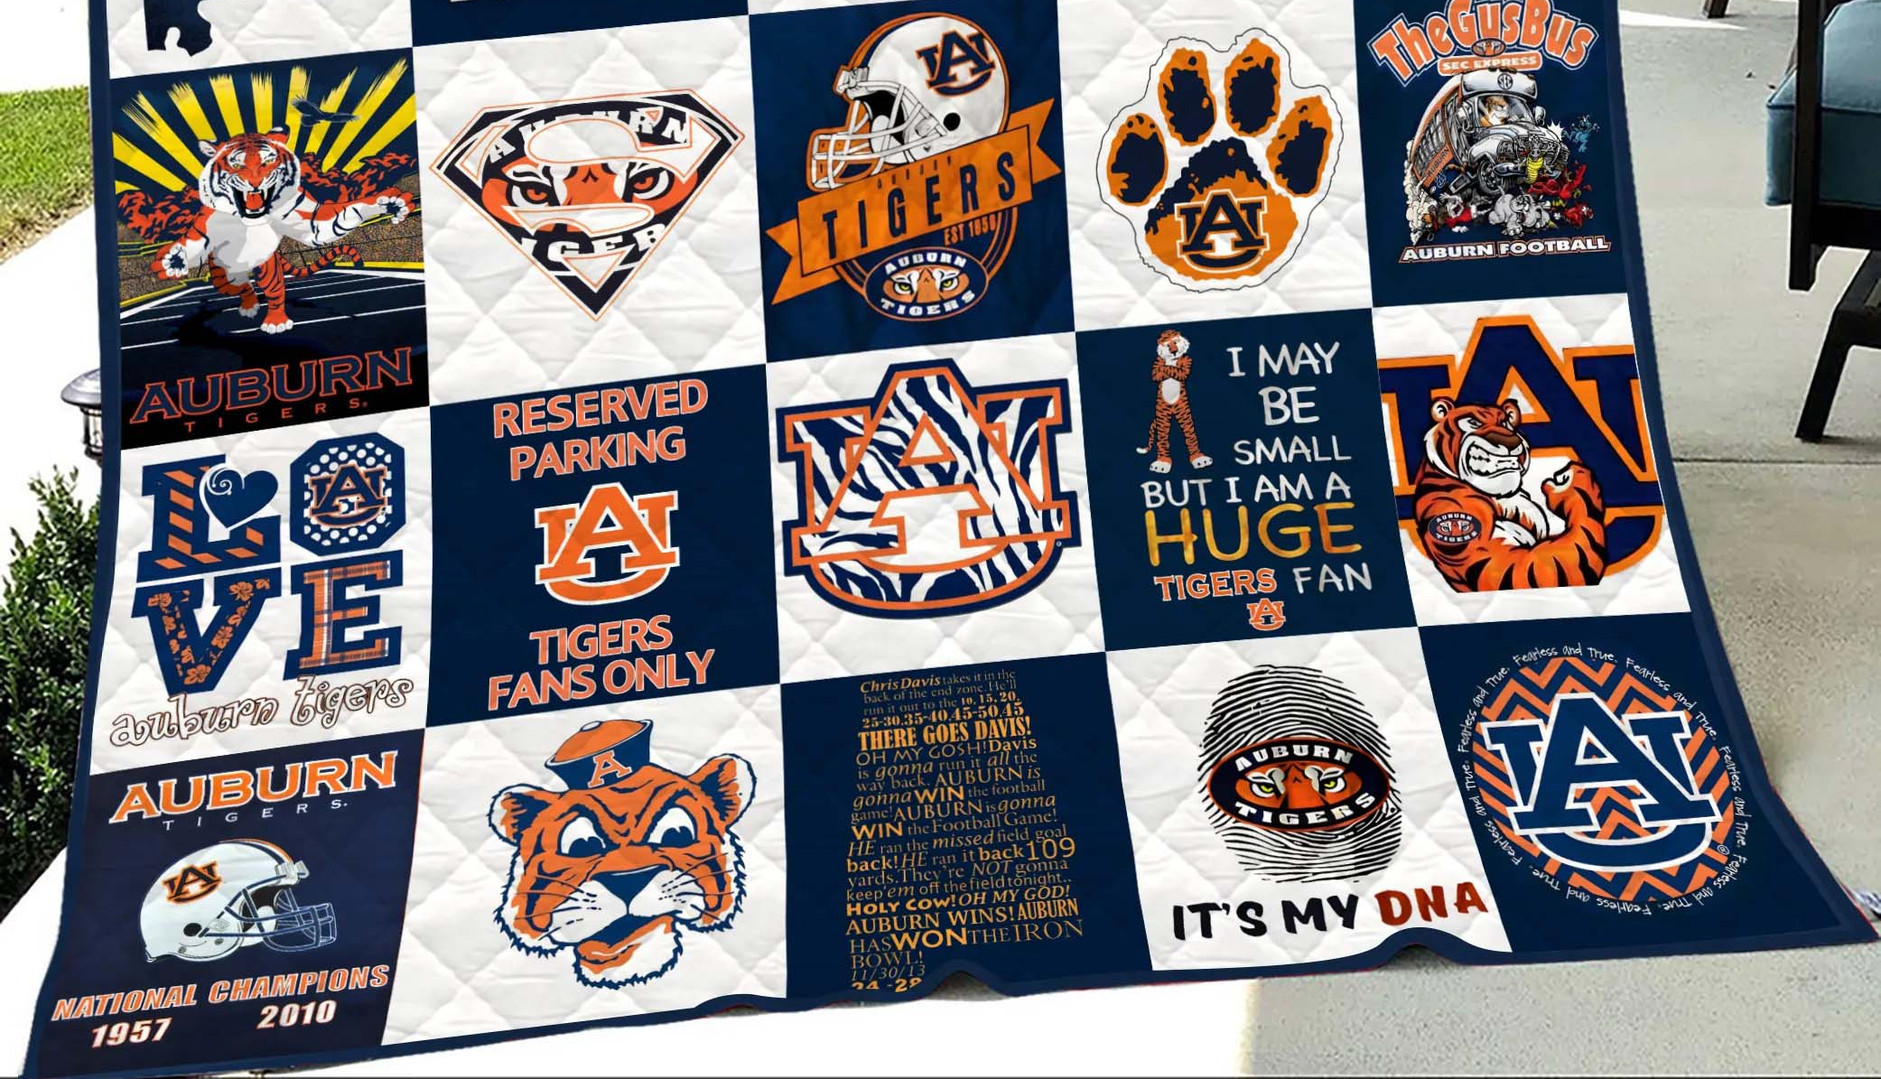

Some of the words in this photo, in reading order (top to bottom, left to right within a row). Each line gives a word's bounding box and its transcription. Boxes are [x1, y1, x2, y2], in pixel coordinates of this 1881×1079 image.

[1443, 60, 1469, 70] SEC
[1474, 56, 1537, 69] EXPRESS
[822, 151, 1015, 259] TIGERS
[944, 222, 964, 246] EST
[1403, 246, 1494, 262] AUBURN
[1500, 237, 1609, 256] FOOTBALL
[884, 252, 967, 274] AUBURN
[880, 290, 976, 316] TIGERS
[1226, 346, 1247, 377] I
[1258, 341, 1340, 377] MAY
[130, 347, 413, 424] AUBURN
[185, 398, 360, 432] TIGERS
[493, 379, 708, 438] RESERVED
[1258, 386, 1320, 426] BE
[510, 426, 686, 481] PARKING
[1233, 435, 1352, 465] SMALL
[1140, 479, 1212, 508] BUT
[1224, 477, 1244, 503] I
[1254, 473, 1314, 502] AM
[1325, 471, 1352, 500] A
[1145, 502, 1362, 567] HUGE
[1154, 568, 1277, 601] TIGERS
[1293, 562, 1372, 593] FAN
[529, 614, 673, 665] TIGERS
[1512, 647, 1558, 666] Fearless
[1563, 642, 1583, 656] and
[488, 664, 596, 711] FANS
[602, 649, 715, 695] ONLY
[860, 679, 899, 693] Chris
[900, 675, 941, 690] Davis
[1625, 657, 1671, 692] Fearless
[1673, 692, 1697, 711] and
[110, 694, 278, 747] auburn
[290, 675, 414, 729] tigers
[858, 727, 917, 751] THERE
[923, 721, 969, 745] GOES
[974, 716, 1031, 740] DAVIS!
[1457, 709, 1478, 753] Fearless
[856, 750, 886, 766] OH
[893, 746, 923, 763] MY
[988, 736, 1037, 752] Davis
[1234, 744, 1353, 772] AUBURN
[588, 750, 632, 788] A
[875, 762, 933, 780] gonna
[935, 765, 1022, 786] AUBURN
[1719, 746, 1742, 792] Fearless
[108, 750, 398, 824] AUBURN
[853, 792, 912, 810] gonna
[914, 785, 964, 804] WIN
[893, 799, 982, 821] AUBURN
[998, 795, 1056, 814] gonna
[1235, 791, 1377, 825] TIGERS
[848, 840, 876, 856] HE
[932, 829, 994, 849] missed
[851, 821, 903, 840] WIN
[978, 844, 1024, 860] back
[1026, 837, 1076, 861] 109
[972, 860, 1013, 876] NOT
[1015, 860, 1069, 877] gonna
[846, 912, 940, 935] AUBURN
[947, 905, 1014, 926] WINS!
[1018, 898, 1079, 920] AUBURN
[847, 901, 900, 916] HOLY
[959, 891, 987, 906] OH
[992, 889, 1020, 903] MY
[1024, 884, 1070, 900] GOD!
[1173, 901, 1268, 940] IT'S
[1281, 893, 1359, 934] MY
[1374, 881, 1489, 926] DNA
[850, 936, 891, 954] HAS
[891, 928, 968, 951] WON
[968, 927, 1011, 944] THE
[1012, 919, 1083, 942] IRON
[852, 950, 923, 969] BOWL!
[51, 984, 197, 1021] NATIONAL
[208, 965, 390, 1005] CHAMPIONS
[91, 1018, 172, 1048] 1957
[256, 1000, 337, 1030] 2010
